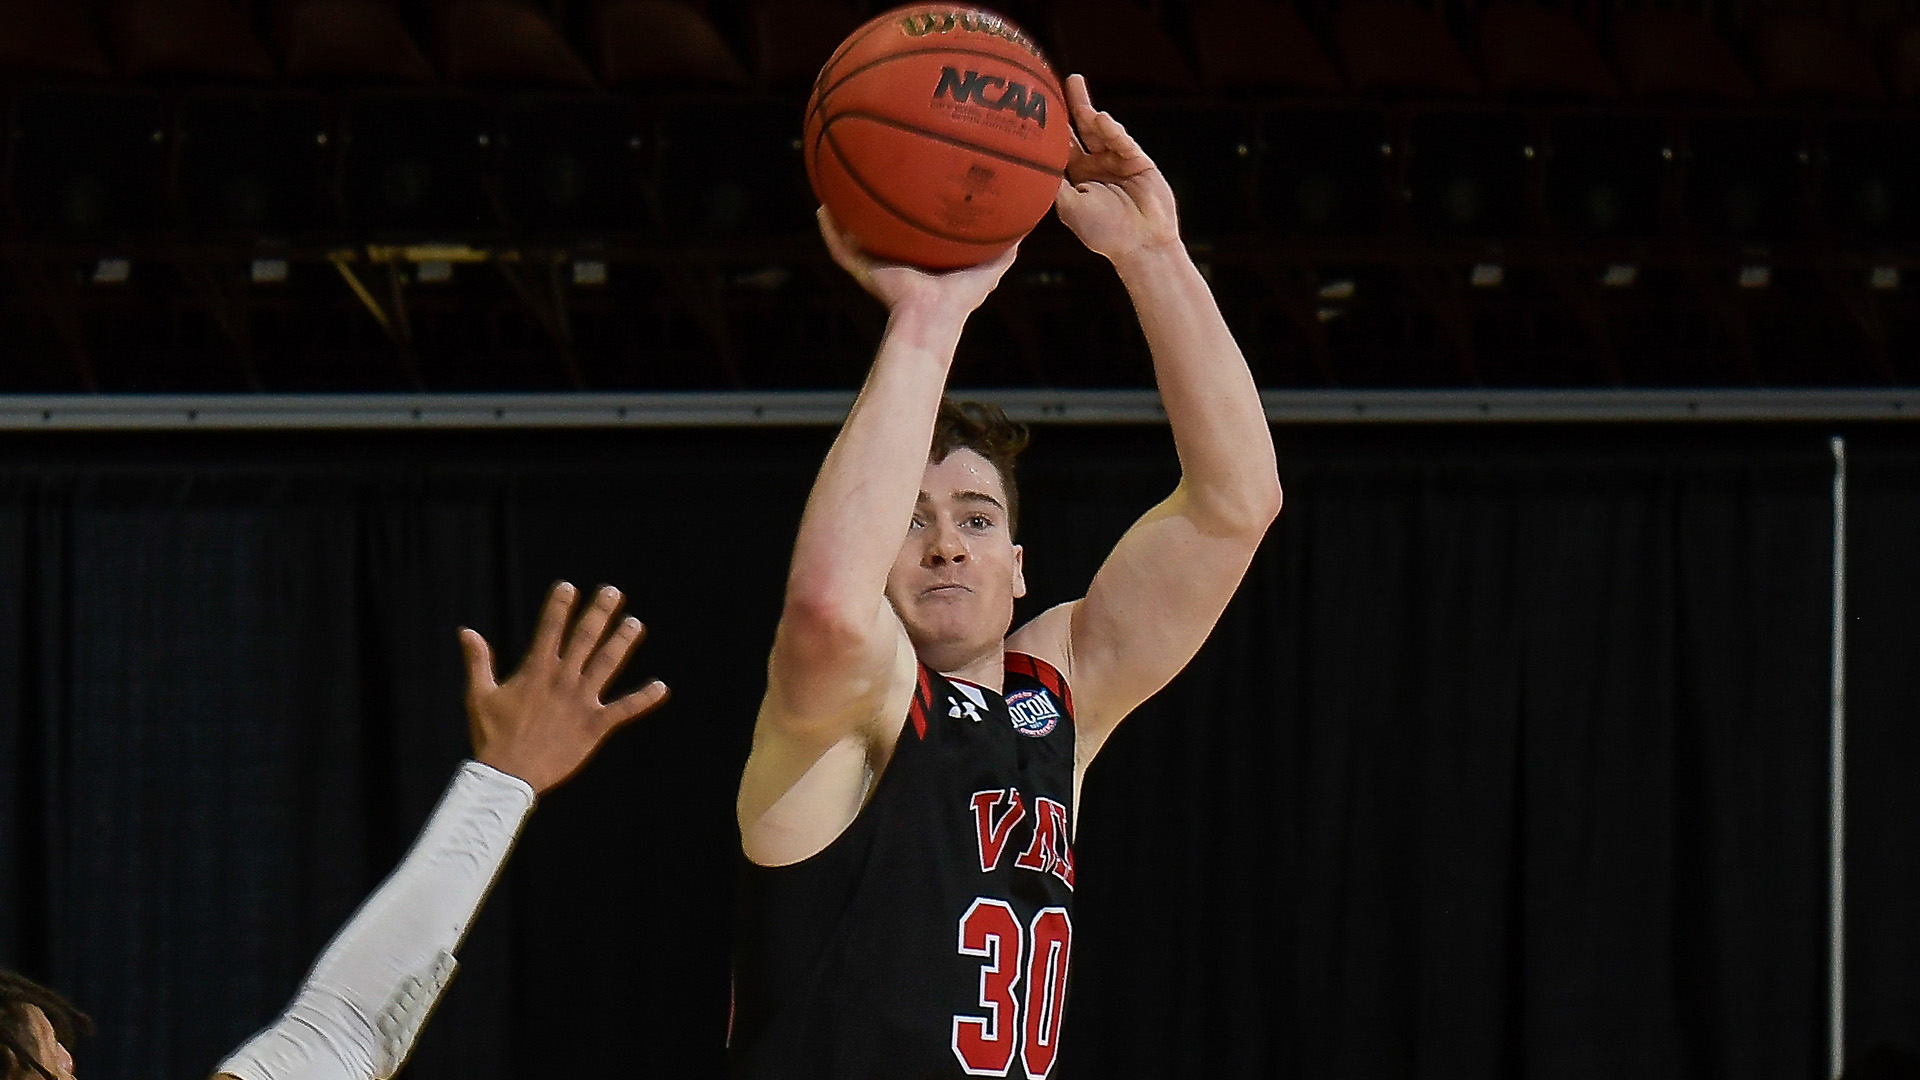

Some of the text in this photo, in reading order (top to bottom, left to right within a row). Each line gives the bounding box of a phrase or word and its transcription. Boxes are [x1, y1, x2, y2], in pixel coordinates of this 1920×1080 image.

[932, 66, 1047, 130] NCAA
[1008, 689, 1060, 729] OCON
[952, 896, 1073, 1080] 30
